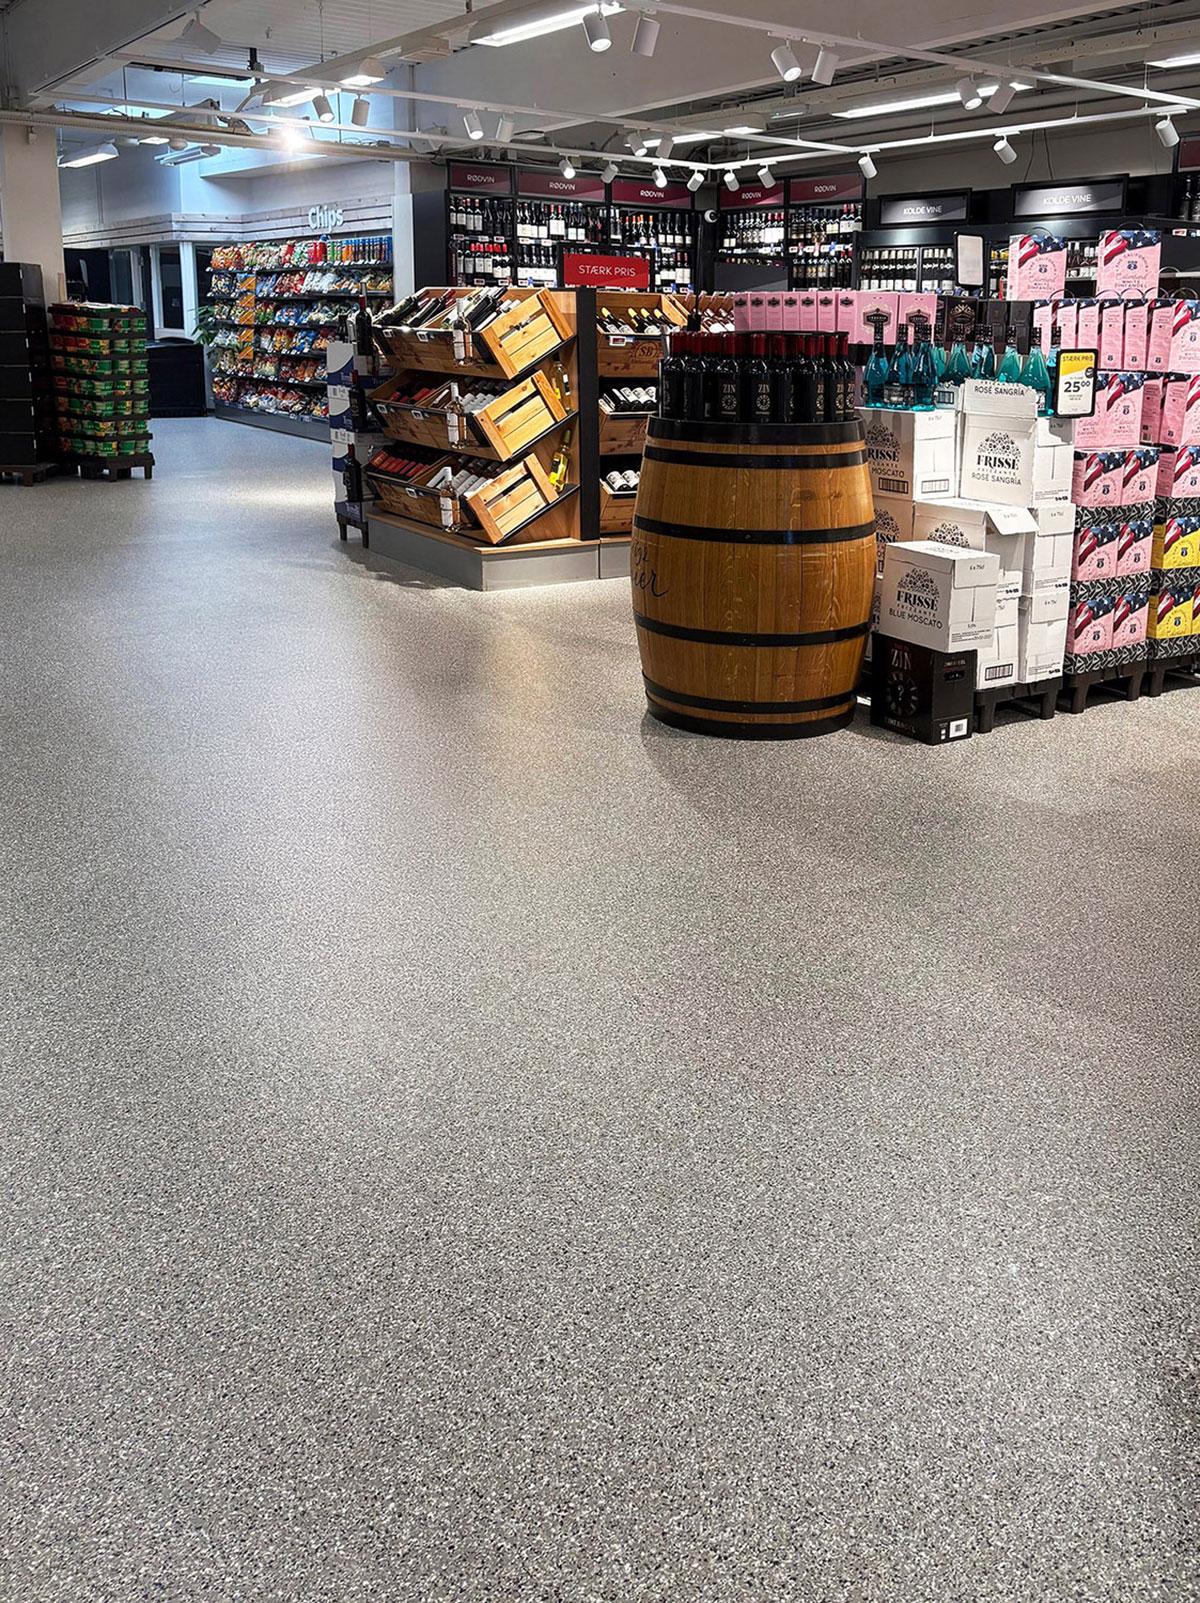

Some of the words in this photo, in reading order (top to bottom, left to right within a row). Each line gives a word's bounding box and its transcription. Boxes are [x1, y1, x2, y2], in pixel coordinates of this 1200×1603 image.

[467, 174, 495, 184] RØDVIN
[549, 182, 576, 191] RØDVIN
[814, 185, 837, 193] RØDVIN
[640, 190, 664, 198] RØDVIN
[1042, 196, 1070, 205] KOLDE
[1071, 194, 1092, 203] VINE
[903, 206, 926, 215] KOLDE
[926, 205, 943, 213] VINE
[308, 205, 344, 233] Chips
[578, 265, 613, 276] STÆRK
[614, 267, 637, 277] PRIS
[722, 384, 736, 393] ZIN
[871, 467, 905, 479] MOSCATO
[888, 608, 906, 620] BLUE
[908, 611, 943, 630] MOSCATO
[890, 648, 912, 671] ZIN
